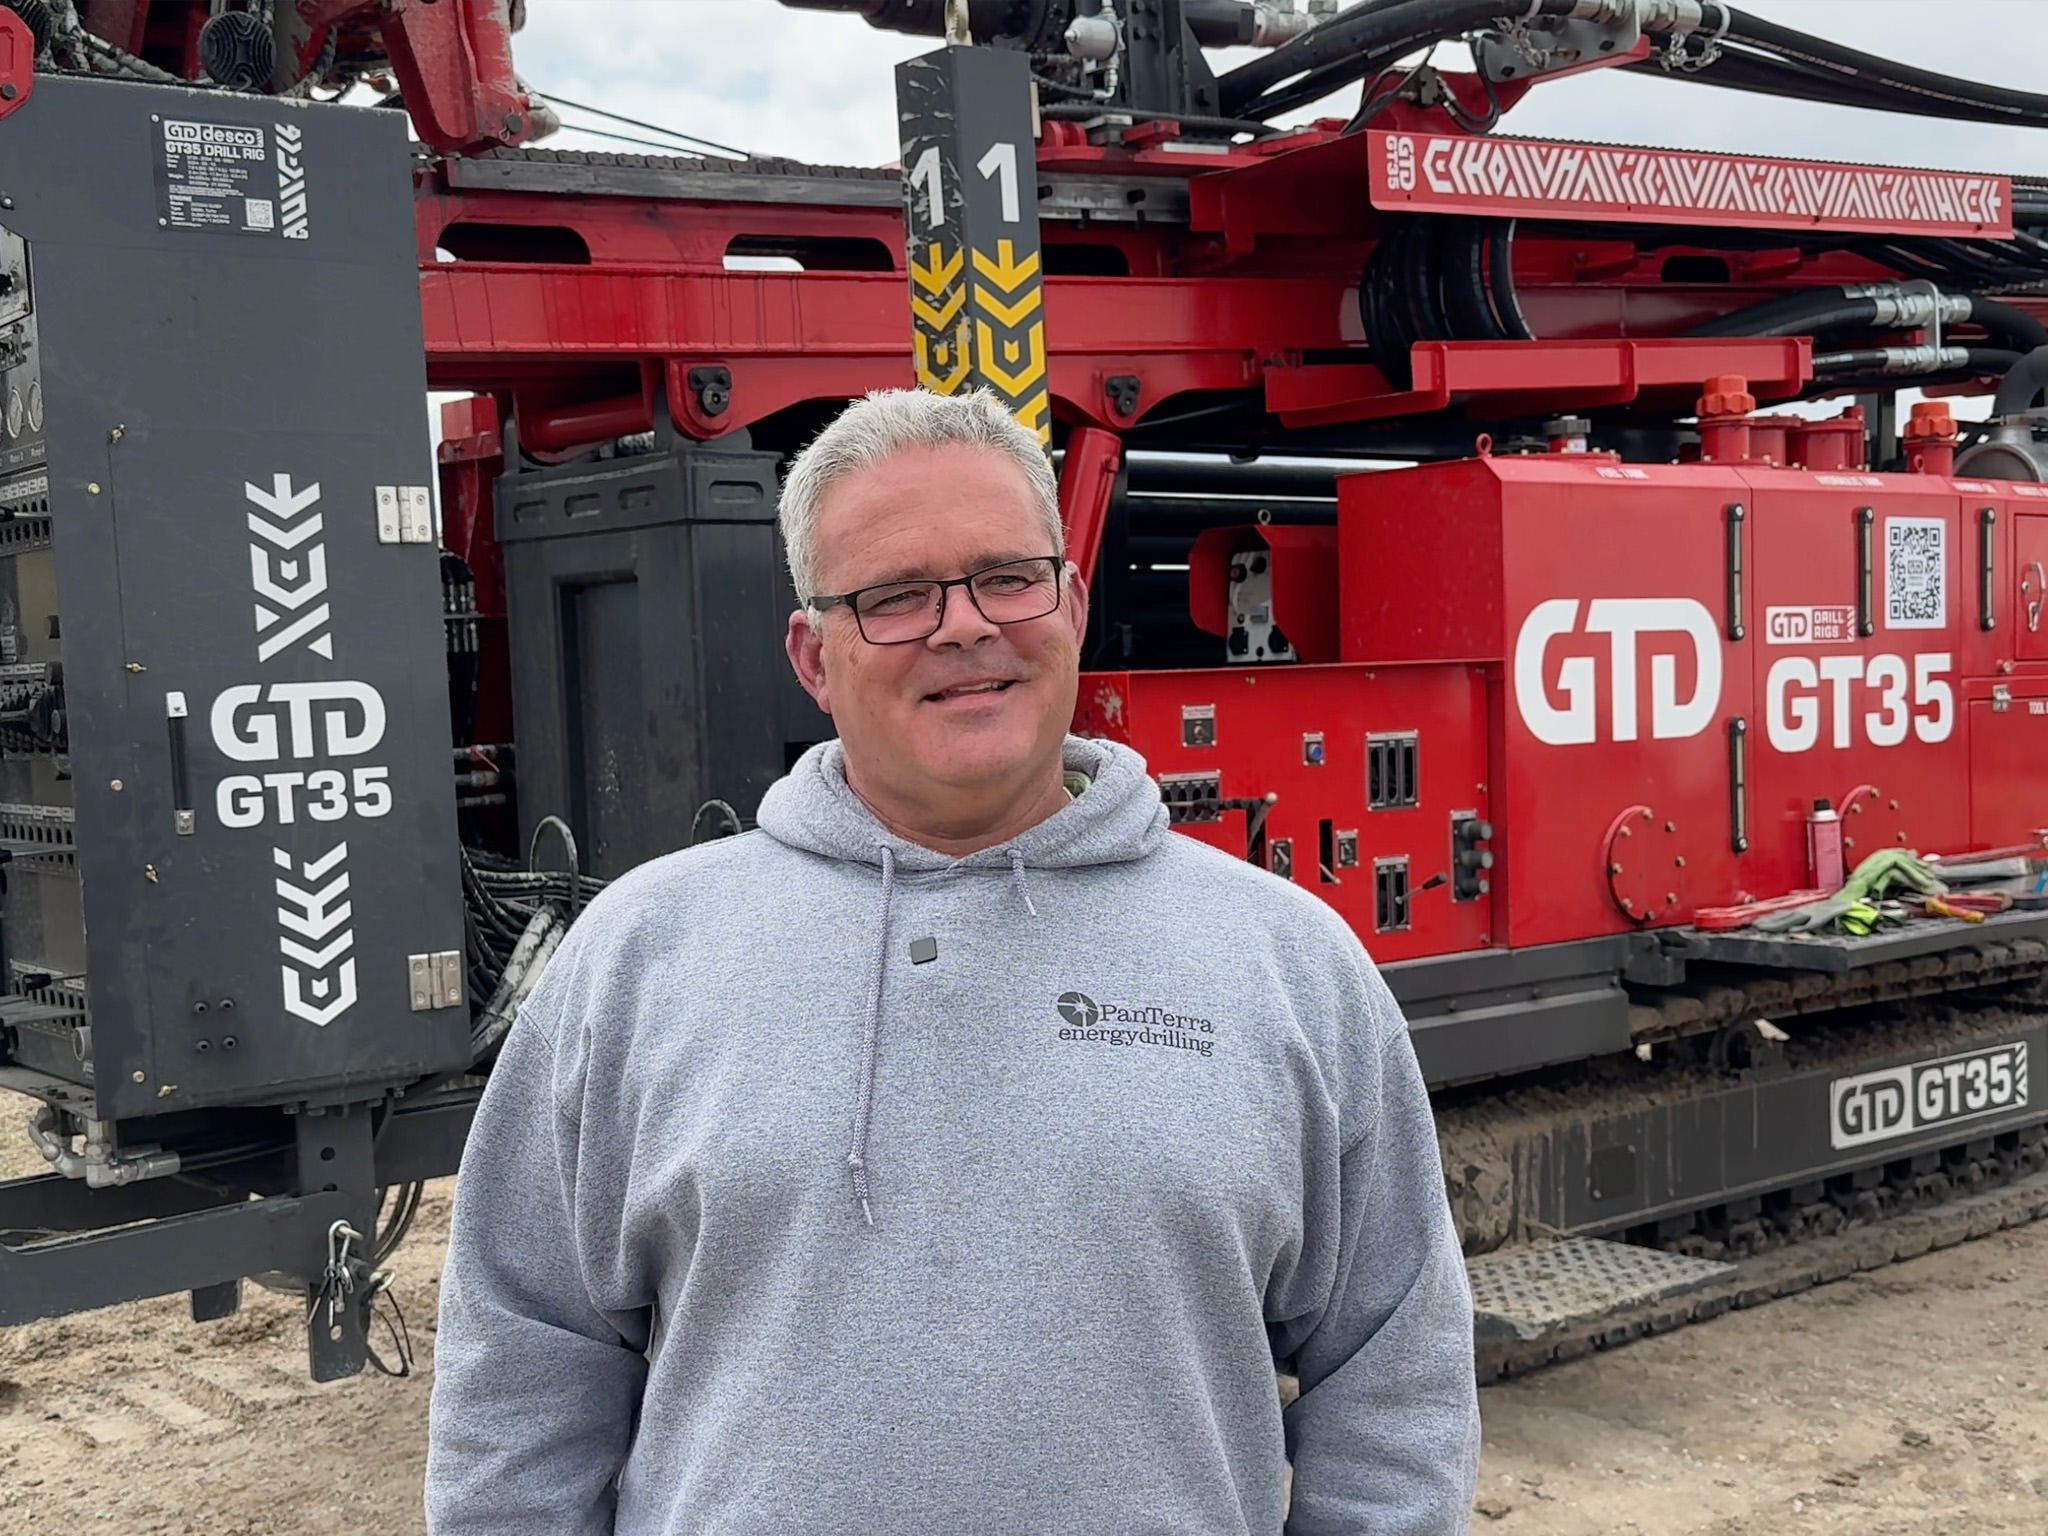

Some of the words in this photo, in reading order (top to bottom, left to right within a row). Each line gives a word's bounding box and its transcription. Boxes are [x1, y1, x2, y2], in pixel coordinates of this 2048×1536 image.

[165, 141, 201, 155] GT35
[204, 145, 241, 158] DRILL
[242, 147, 265, 161] RIG
[168, 124, 197, 139] GTD
[203, 126, 255, 144] desco
[1385, 134, 1400, 190] GT35
[910, 144, 945, 228] 1
[976, 142, 1020, 222] 1
[1398, 136, 1417, 192] GTD
[1771, 612, 1808, 638] GTD
[1813, 611, 1844, 624] DRILL
[1814, 625, 1839, 638] RIGS
[1515, 598, 1722, 745] GTD
[210, 680, 386, 761] GTD
[1766, 653, 1954, 753] GT35
[216, 766, 392, 828] GT35
[1058, 1026, 1214, 1058] energydrilling
[1101, 1004, 1214, 1034] PanTerra
[1838, 1078, 1905, 1137] GTD
[1917, 1053, 2013, 1121] GT35
